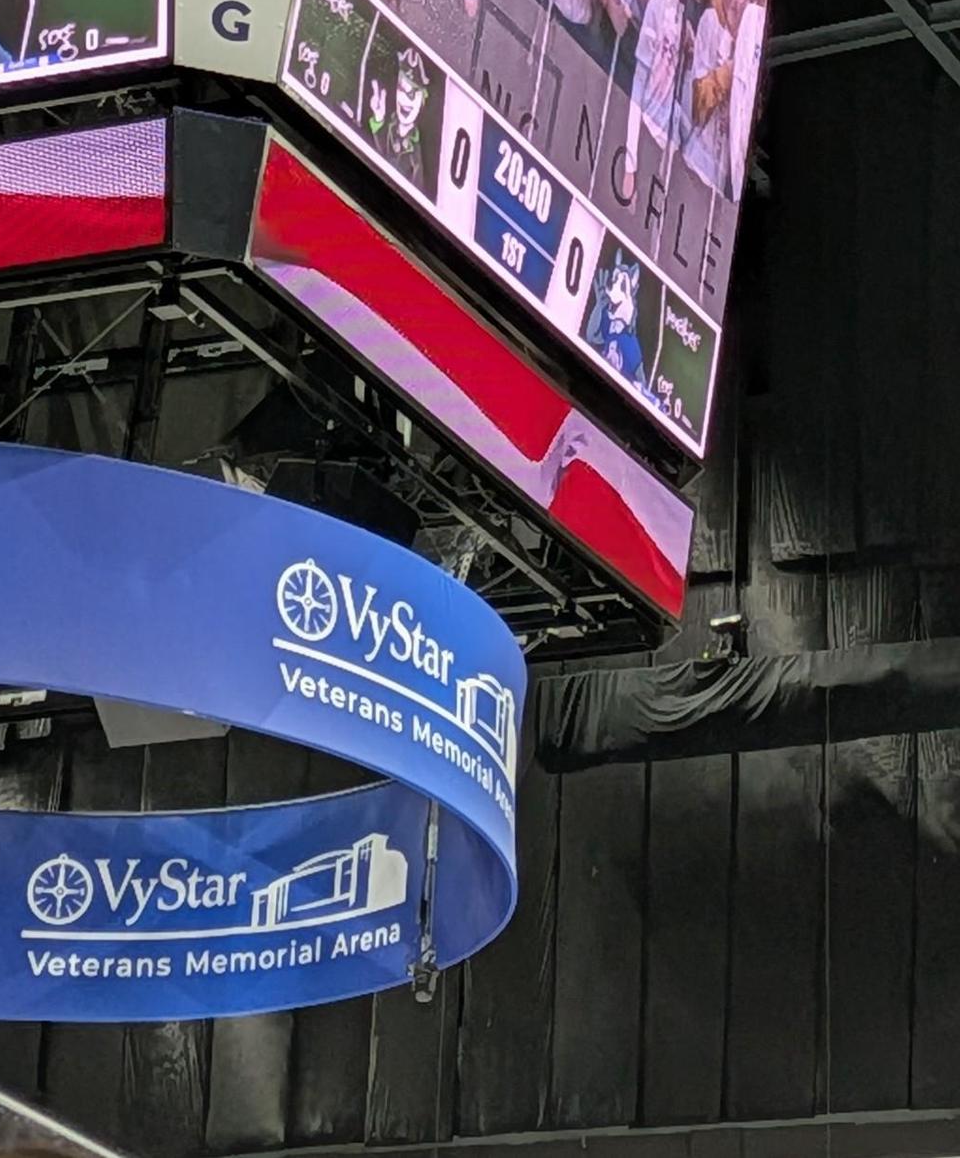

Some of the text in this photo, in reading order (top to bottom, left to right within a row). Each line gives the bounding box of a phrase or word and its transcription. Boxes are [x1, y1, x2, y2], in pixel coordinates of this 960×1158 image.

[450, 127, 472, 191] 0
[494, 139, 553, 225] 20:00
[501, 230, 527, 275] 1ST
[565, 235, 584, 296] 0
[337, 573, 455, 686] VyStar
[279, 663, 404, 734] Veterans
[412, 715, 494, 795] Memorial
[94, 858, 247, 927] VyStar
[28, 922, 401, 978] Veterans Memorial Arena
